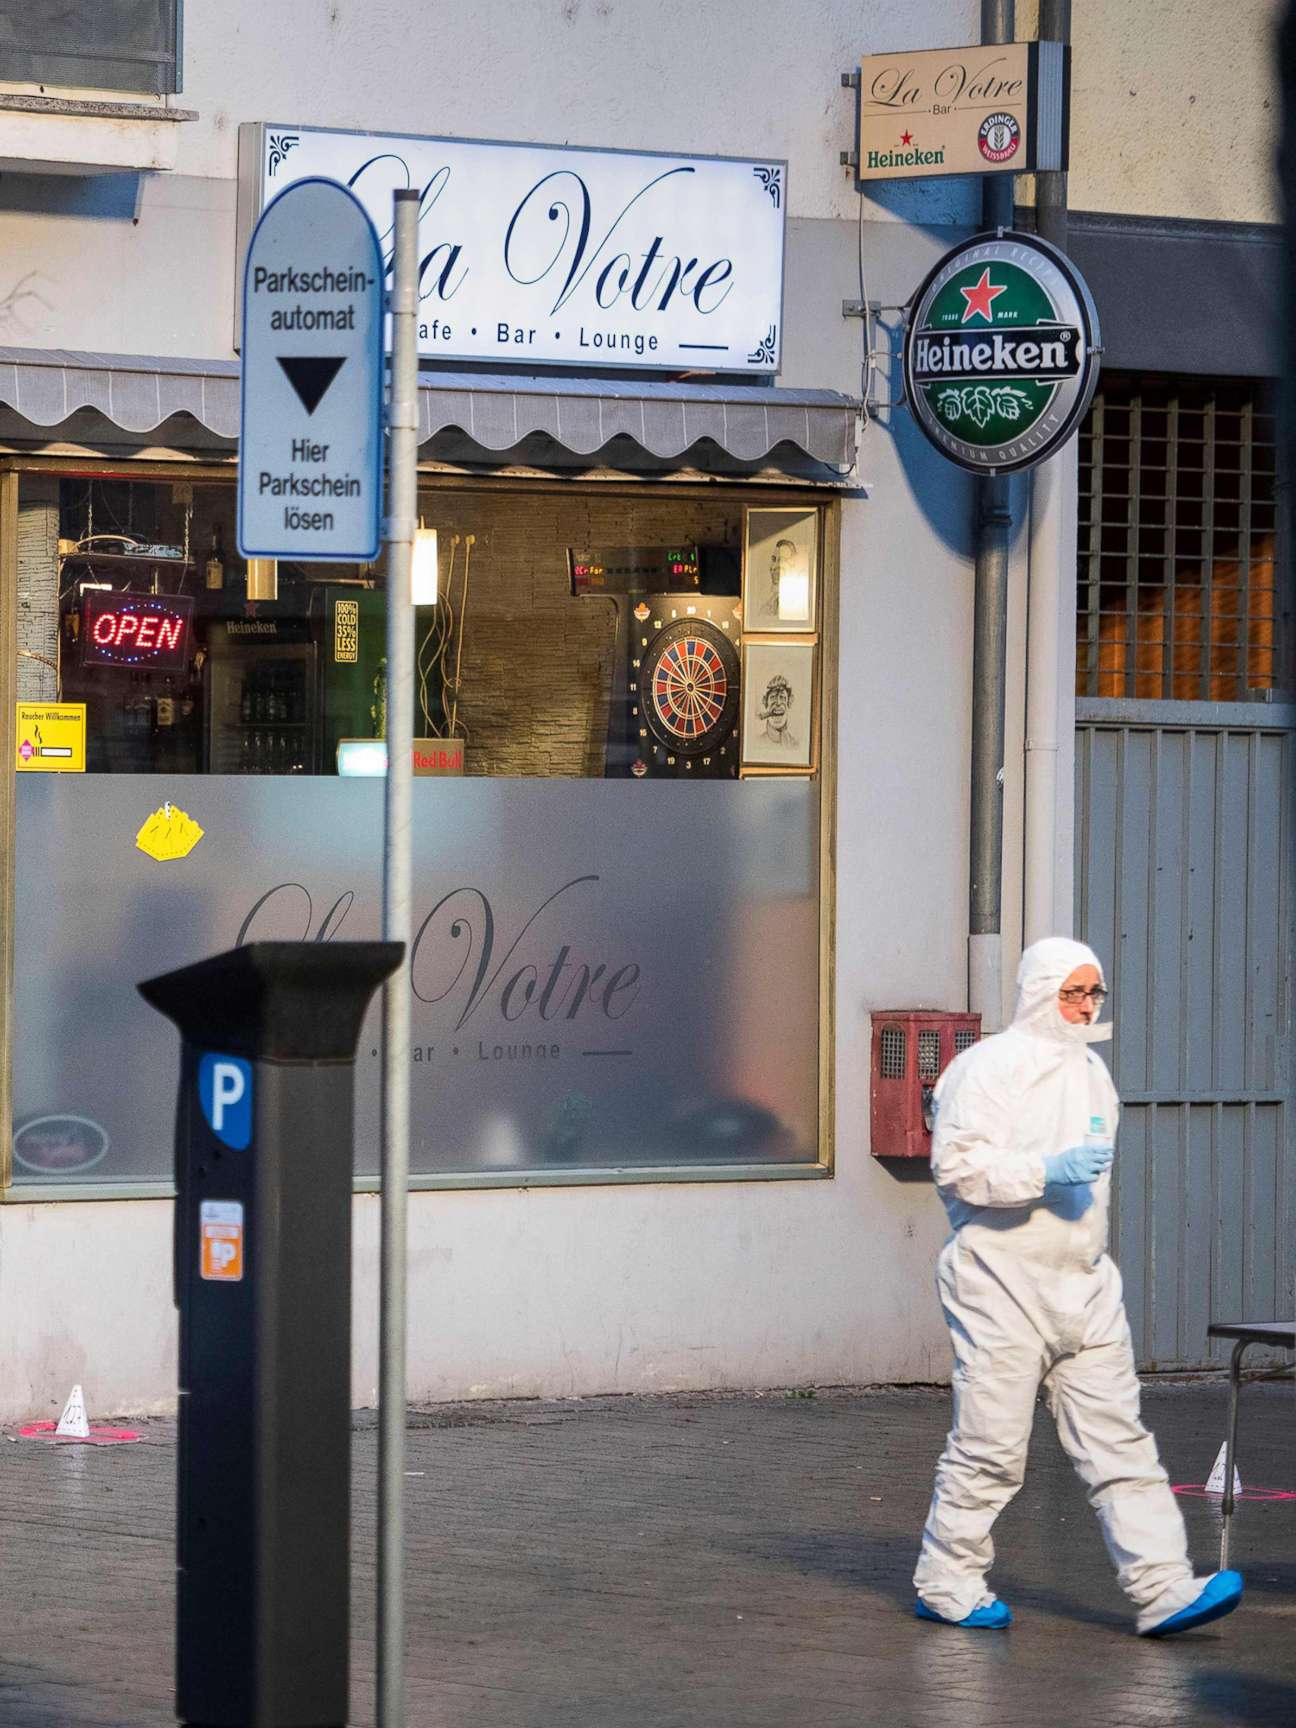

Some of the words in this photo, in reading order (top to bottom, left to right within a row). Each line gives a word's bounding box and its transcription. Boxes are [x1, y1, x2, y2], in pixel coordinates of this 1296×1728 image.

[864, 67, 921, 108] La
[934, 57, 1022, 104] Votre
[932, 104, 951, 116] Bar
[867, 147, 945, 168] Heineken
[505, 166, 734, 316] Votre
[253, 265, 375, 293] Parkschein-
[270, 304, 355, 331] automat
[418, 321, 453, 342] afe
[497, 323, 536, 345] Bar
[580, 327, 659, 352] Lounge
[915, 335, 1069, 373] Heineken
[291, 438, 330, 463] Hier
[998, 415, 1061, 460] QUALITY
[259, 471, 361, 498] Parkschein
[284, 505, 334, 532] lösen
[337, 603, 356, 614] 100%
[337, 614, 356, 625] COLD
[93, 614, 183, 649] OPEN
[226, 620, 277, 635] Heineken
[337, 625, 356, 638] 35%
[337, 638, 356, 651] LESS
[21, 711, 45, 721] Raucher
[45, 711, 81, 721] Willkommen
[413, 751, 436, 768] Red
[439, 751, 462, 768] Bull
[410, 874, 642, 1032] Votre
[413, 1046, 435, 1062] ar
[478, 1040, 561, 1063] Lounge
[212, 1062, 245, 1132] P
